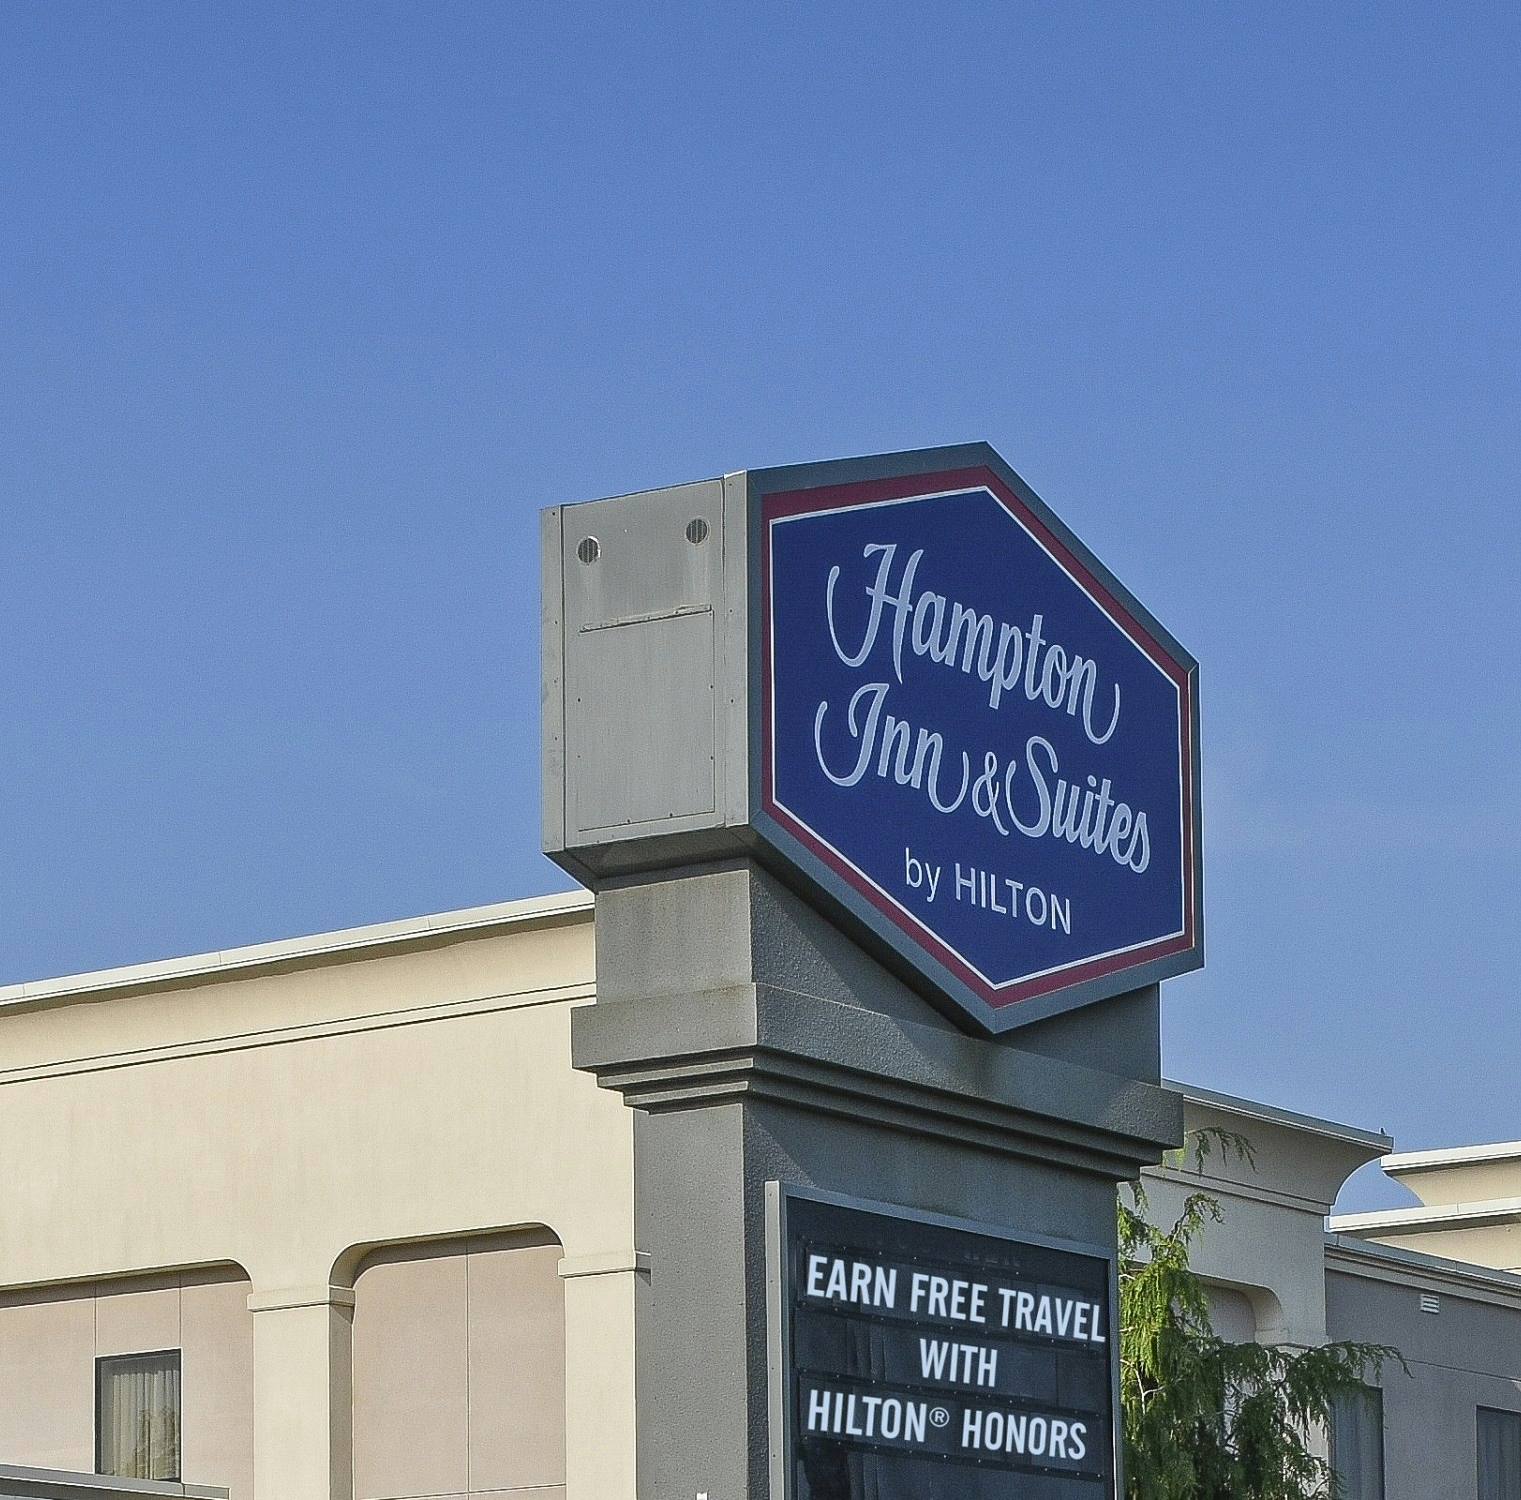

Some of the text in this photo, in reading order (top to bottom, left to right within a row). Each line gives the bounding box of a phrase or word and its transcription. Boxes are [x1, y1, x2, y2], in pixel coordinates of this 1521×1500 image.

[826, 543, 1121, 745] Hampton
[814, 682, 1151, 874] Inn & Suites
[905, 847, 1072, 935] by HILTON
[806, 1253, 1106, 1343] EARN FREE TRAVEL
[919, 1337, 998, 1388] WITH
[961, 1408, 1088, 1461] HONORS
